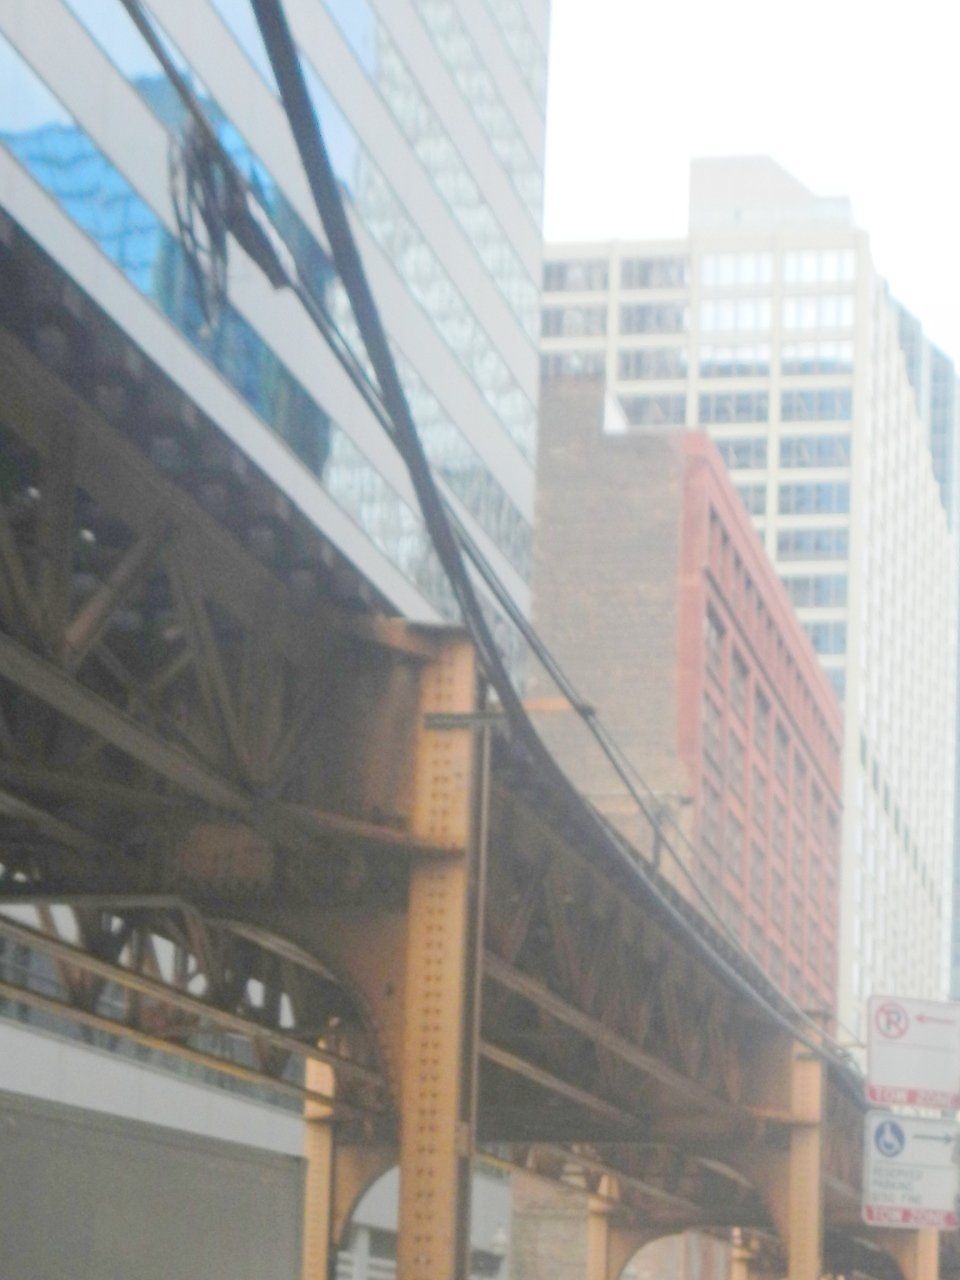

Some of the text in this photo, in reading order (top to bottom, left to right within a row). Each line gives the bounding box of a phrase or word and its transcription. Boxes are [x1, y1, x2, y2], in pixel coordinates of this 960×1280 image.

[875, 1087, 951, 1109] TOW ZONE
[872, 1205, 946, 1227] TOW ZONE
